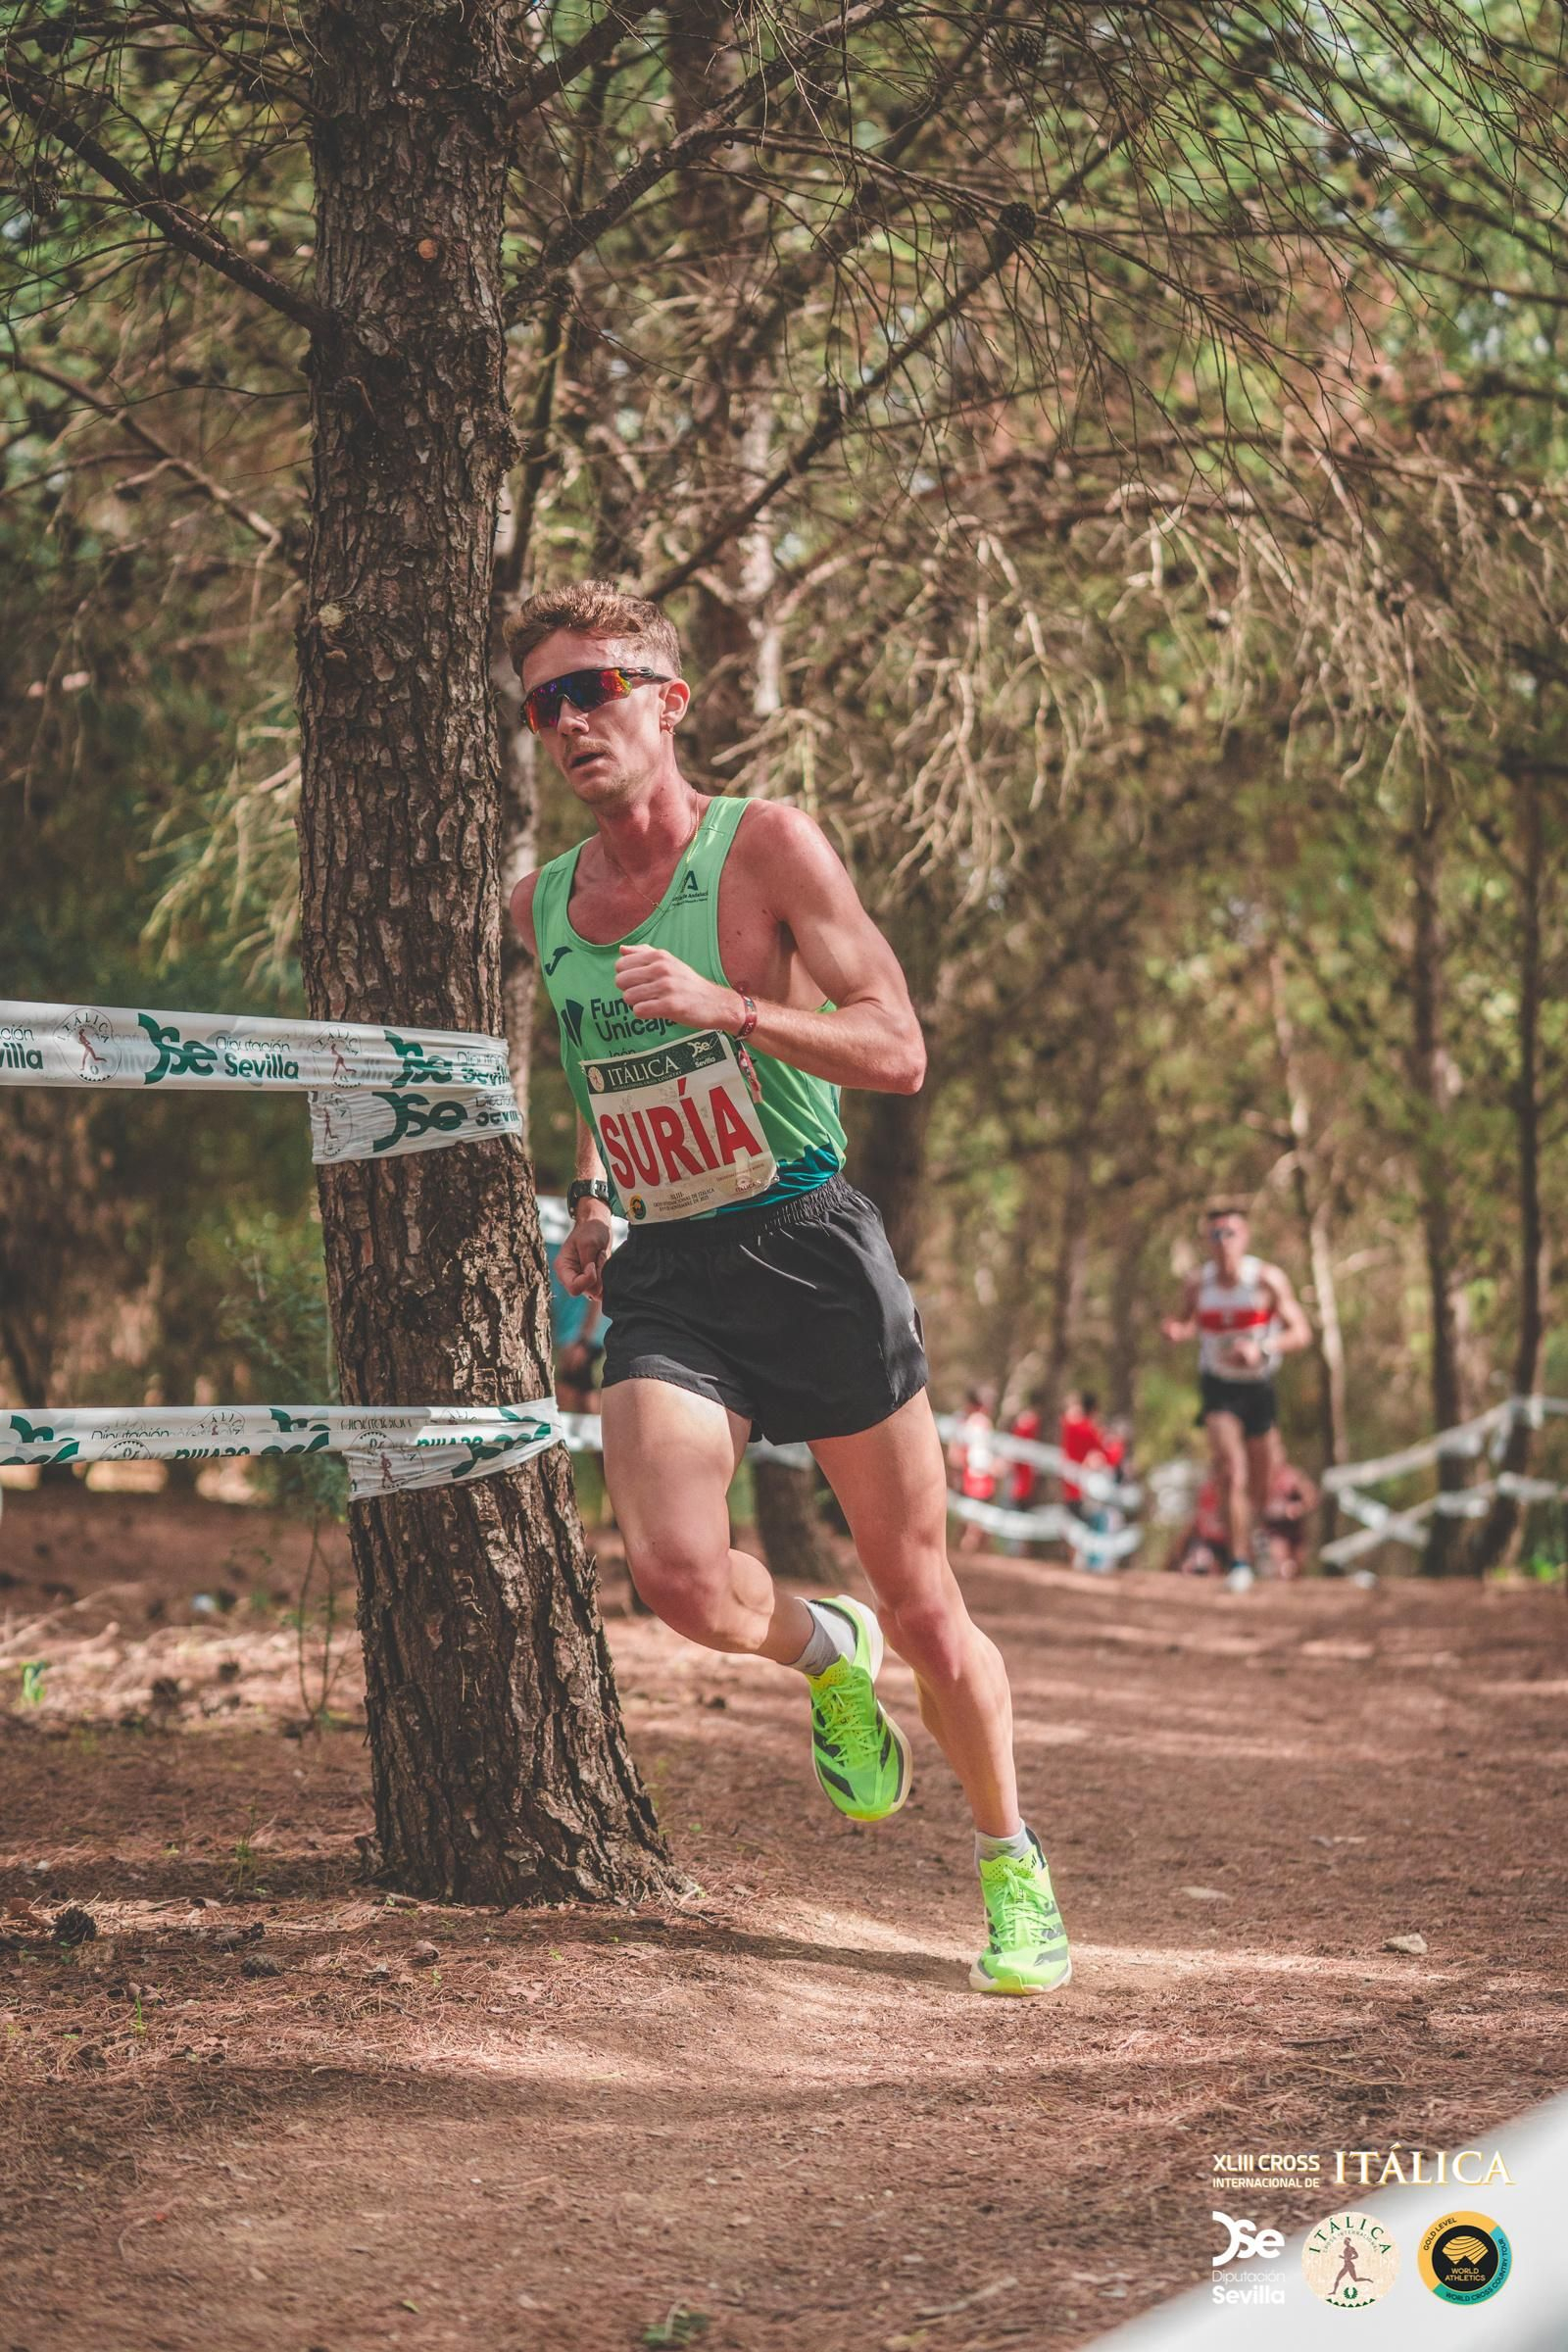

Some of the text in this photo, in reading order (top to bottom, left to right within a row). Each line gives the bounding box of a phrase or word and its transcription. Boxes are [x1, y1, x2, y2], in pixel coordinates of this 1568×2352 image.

[591, 998, 633, 1019] Fun
[224, 1052, 299, 1080] Sevilla
[608, 1055, 681, 1087] ITÁLICA
[601, 1076, 762, 1189] SURÍA
